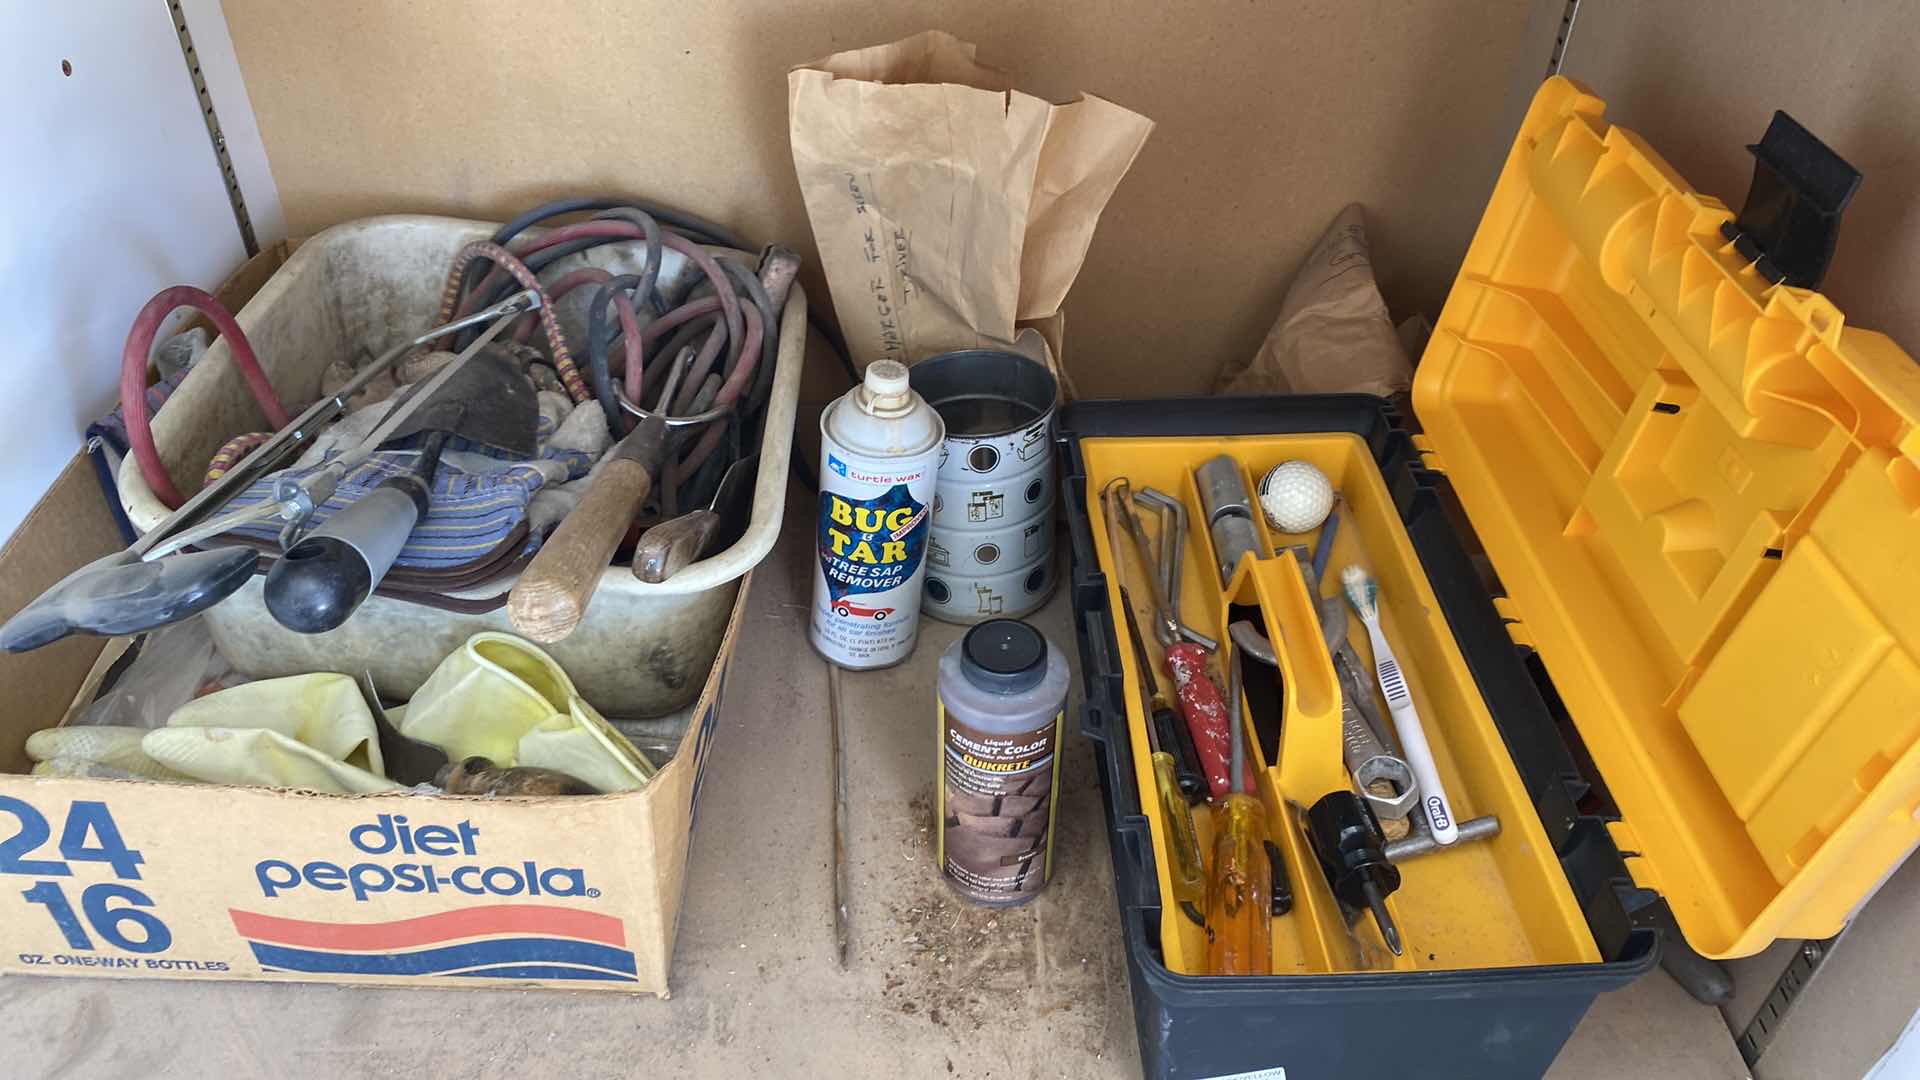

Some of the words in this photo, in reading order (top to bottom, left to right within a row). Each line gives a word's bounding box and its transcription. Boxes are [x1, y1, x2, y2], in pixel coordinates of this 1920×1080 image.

[851, 471, 892, 483] turtle
[896, 472, 921, 483] wax
[830, 495, 914, 533] BUG
[828, 527, 908, 564] TAR
[828, 568, 903, 588] REMOVER
[832, 557, 867, 577] TREE
[871, 565, 903, 577] SAP
[950, 728, 1001, 755] CEMENT
[1004, 737, 1048, 755] COLOR
[984, 738, 1014, 747] Liquid
[962, 753, 1031, 772] QUIKRETE
[0, 795, 146, 881] 24
[349, 814, 480, 857] diet
[21, 880, 173, 955] 16
[144, 958, 231, 972] BOTTLES
